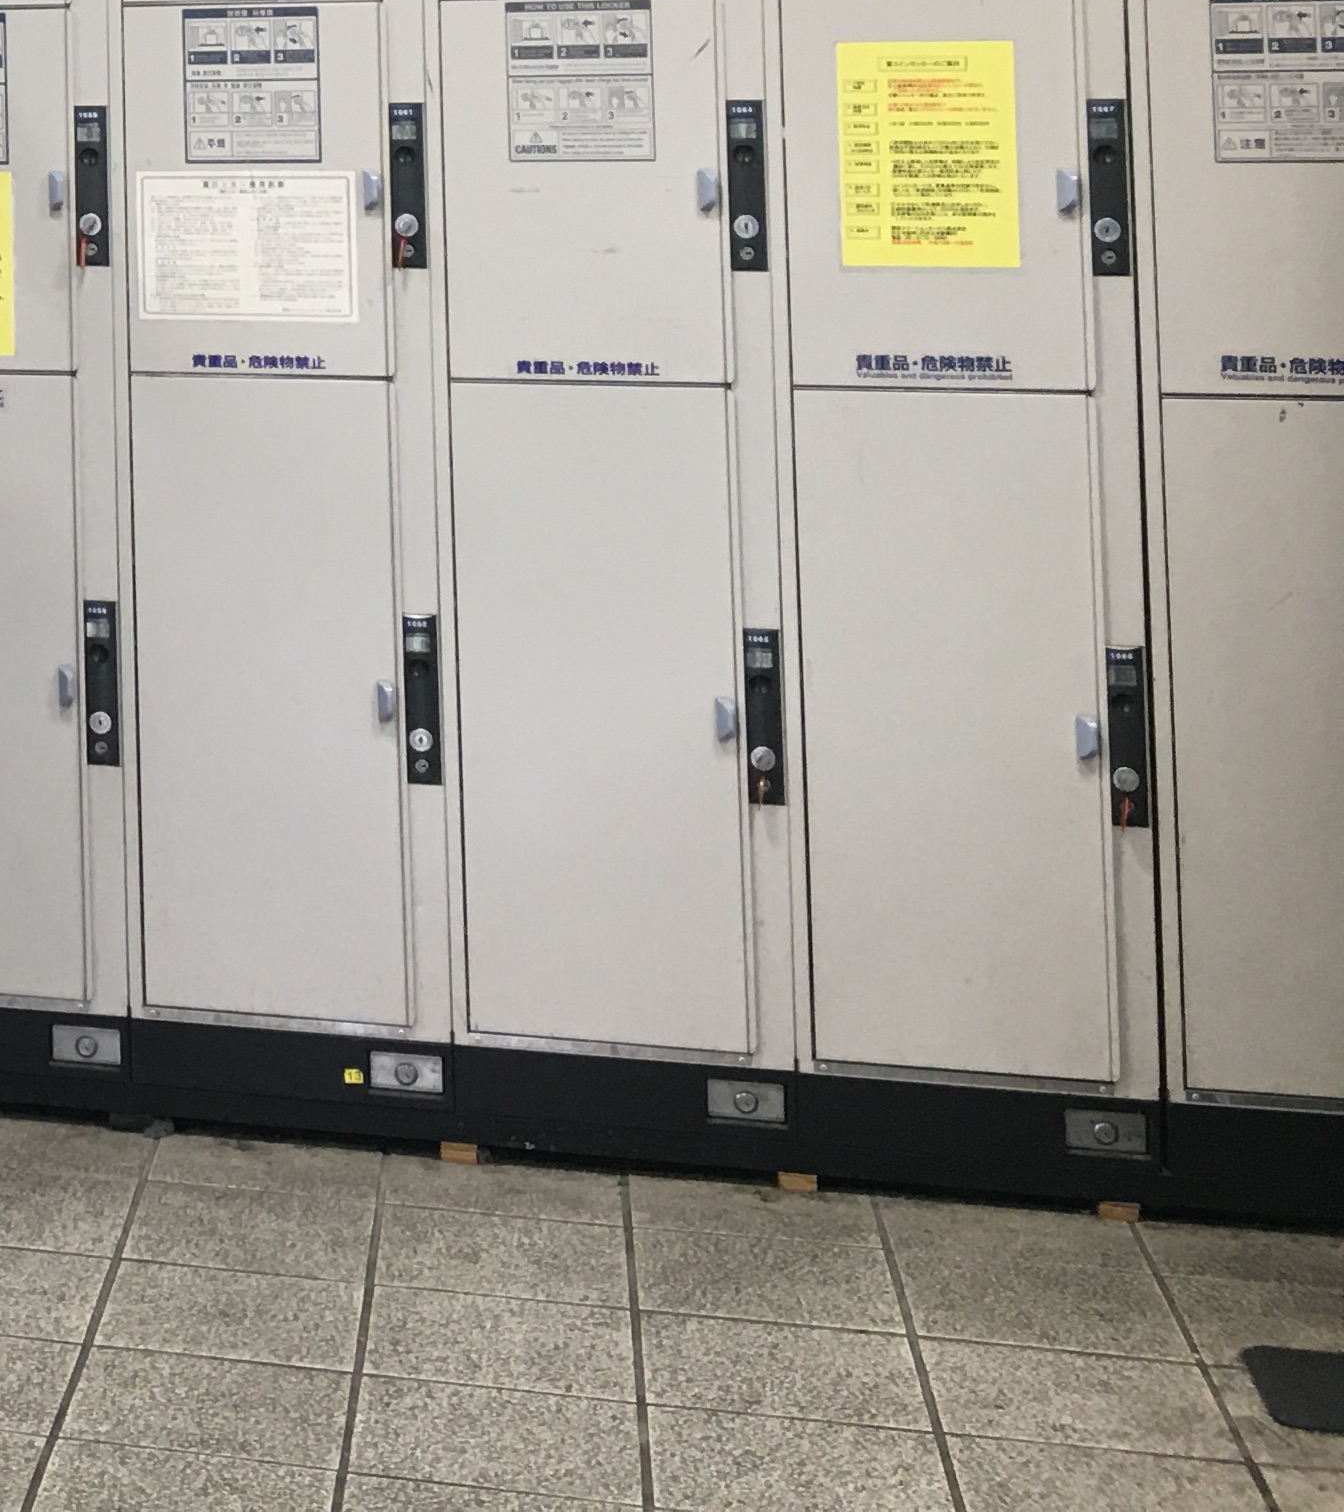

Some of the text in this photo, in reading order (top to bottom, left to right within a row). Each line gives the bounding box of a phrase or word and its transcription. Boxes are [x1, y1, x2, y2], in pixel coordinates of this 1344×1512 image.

[515, 145, 558, 154] CAUTIONS
[1239, 138, 1266, 149] 注意
[192, 354, 326, 370] 貴重品・危険物禁止
[517, 360, 660, 376] 貴重品・危険物禁止
[856, 354, 1012, 372] 貴重品・危険物禁止
[1221, 355, 1344, 375] 貴重品・危険物
[857, 371, 898, 379] Valuables
[919, 373, 965, 381] dangerous
[349, 1071, 362, 1081] 13
